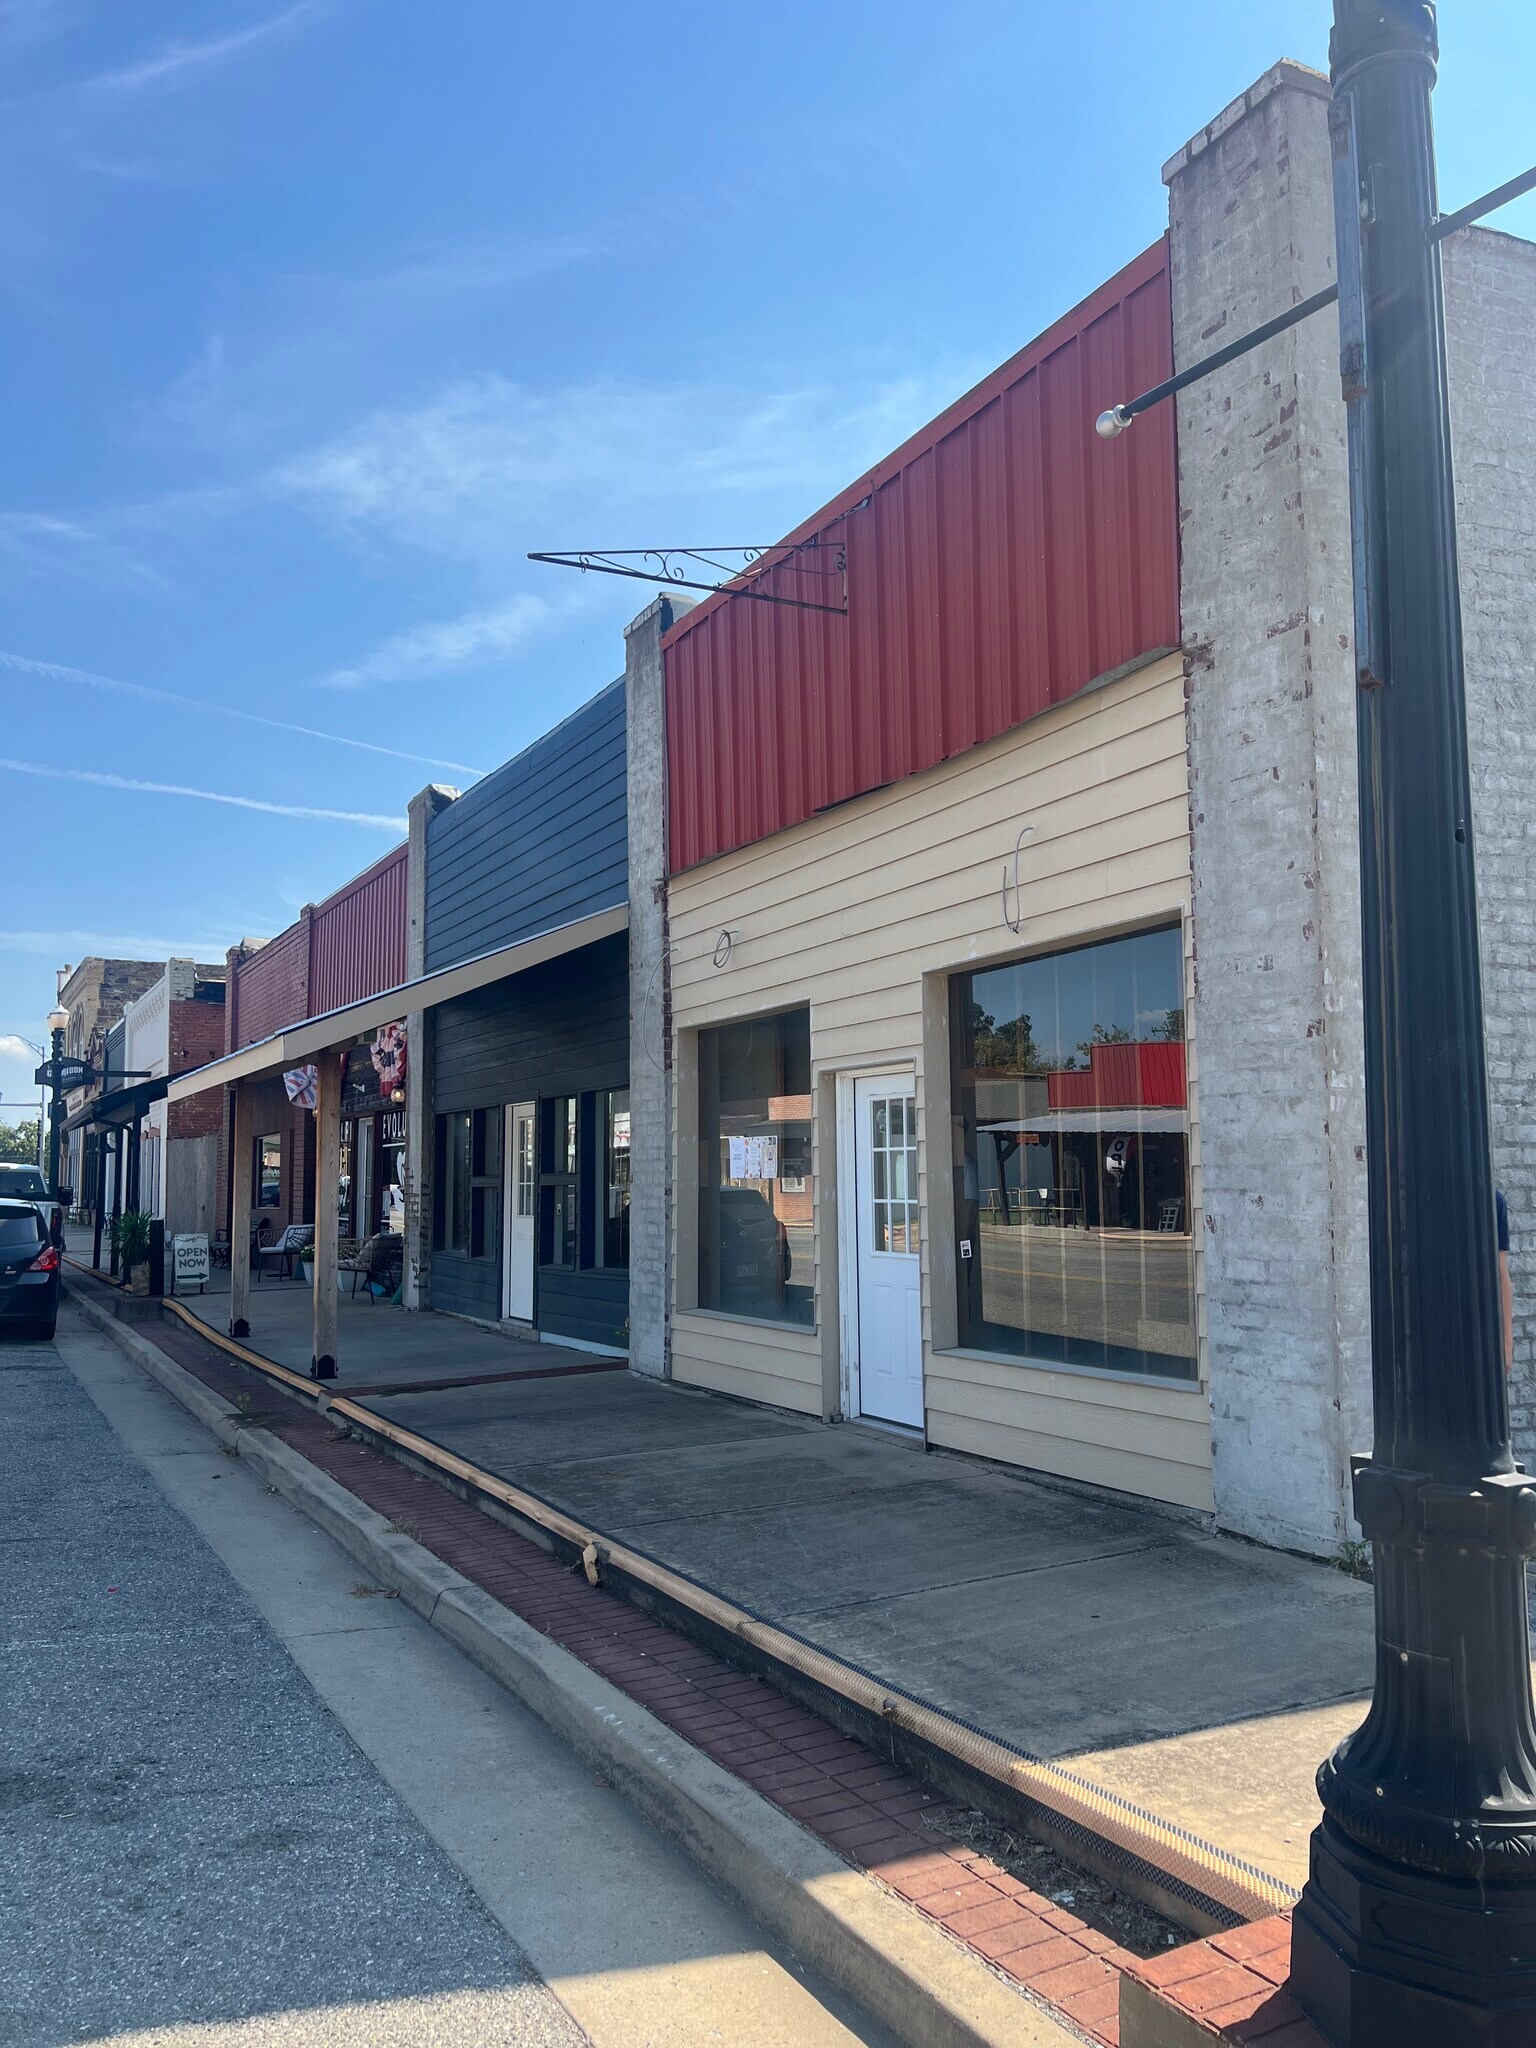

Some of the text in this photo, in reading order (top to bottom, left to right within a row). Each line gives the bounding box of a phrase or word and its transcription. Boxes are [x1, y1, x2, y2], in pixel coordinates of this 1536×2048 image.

[47, 1066, 84, 1077] GRISON
[178, 1248, 207, 1257] OPEN
[179, 1258, 206, 1268] NOW
